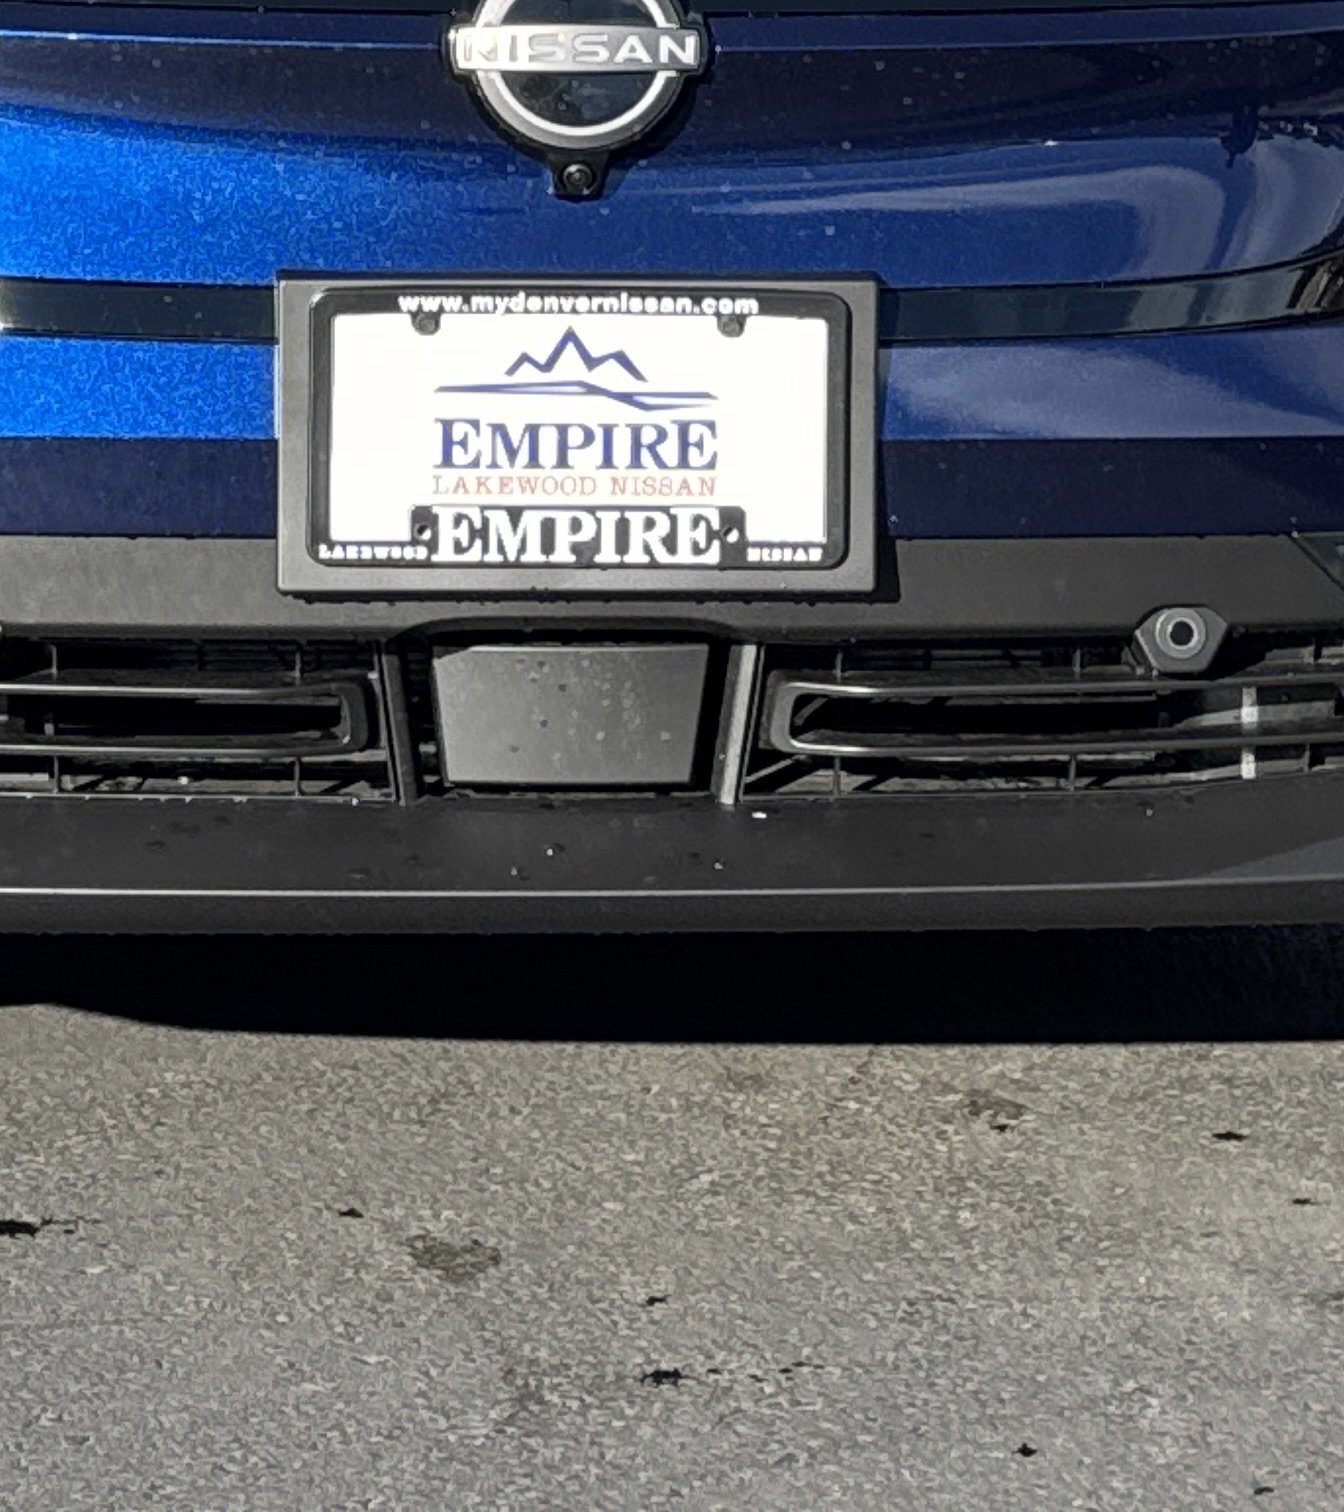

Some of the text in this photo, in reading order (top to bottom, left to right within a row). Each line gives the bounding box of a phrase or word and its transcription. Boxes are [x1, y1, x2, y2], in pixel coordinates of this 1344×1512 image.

[462, 34, 697, 65] NISSAN
[397, 290, 759, 315] www.mydenvernissan.com
[433, 419, 718, 469] EMPIRE
[432, 475, 717, 496] LAKEWOOD NISSAN
[430, 505, 720, 564] EMPIRE
